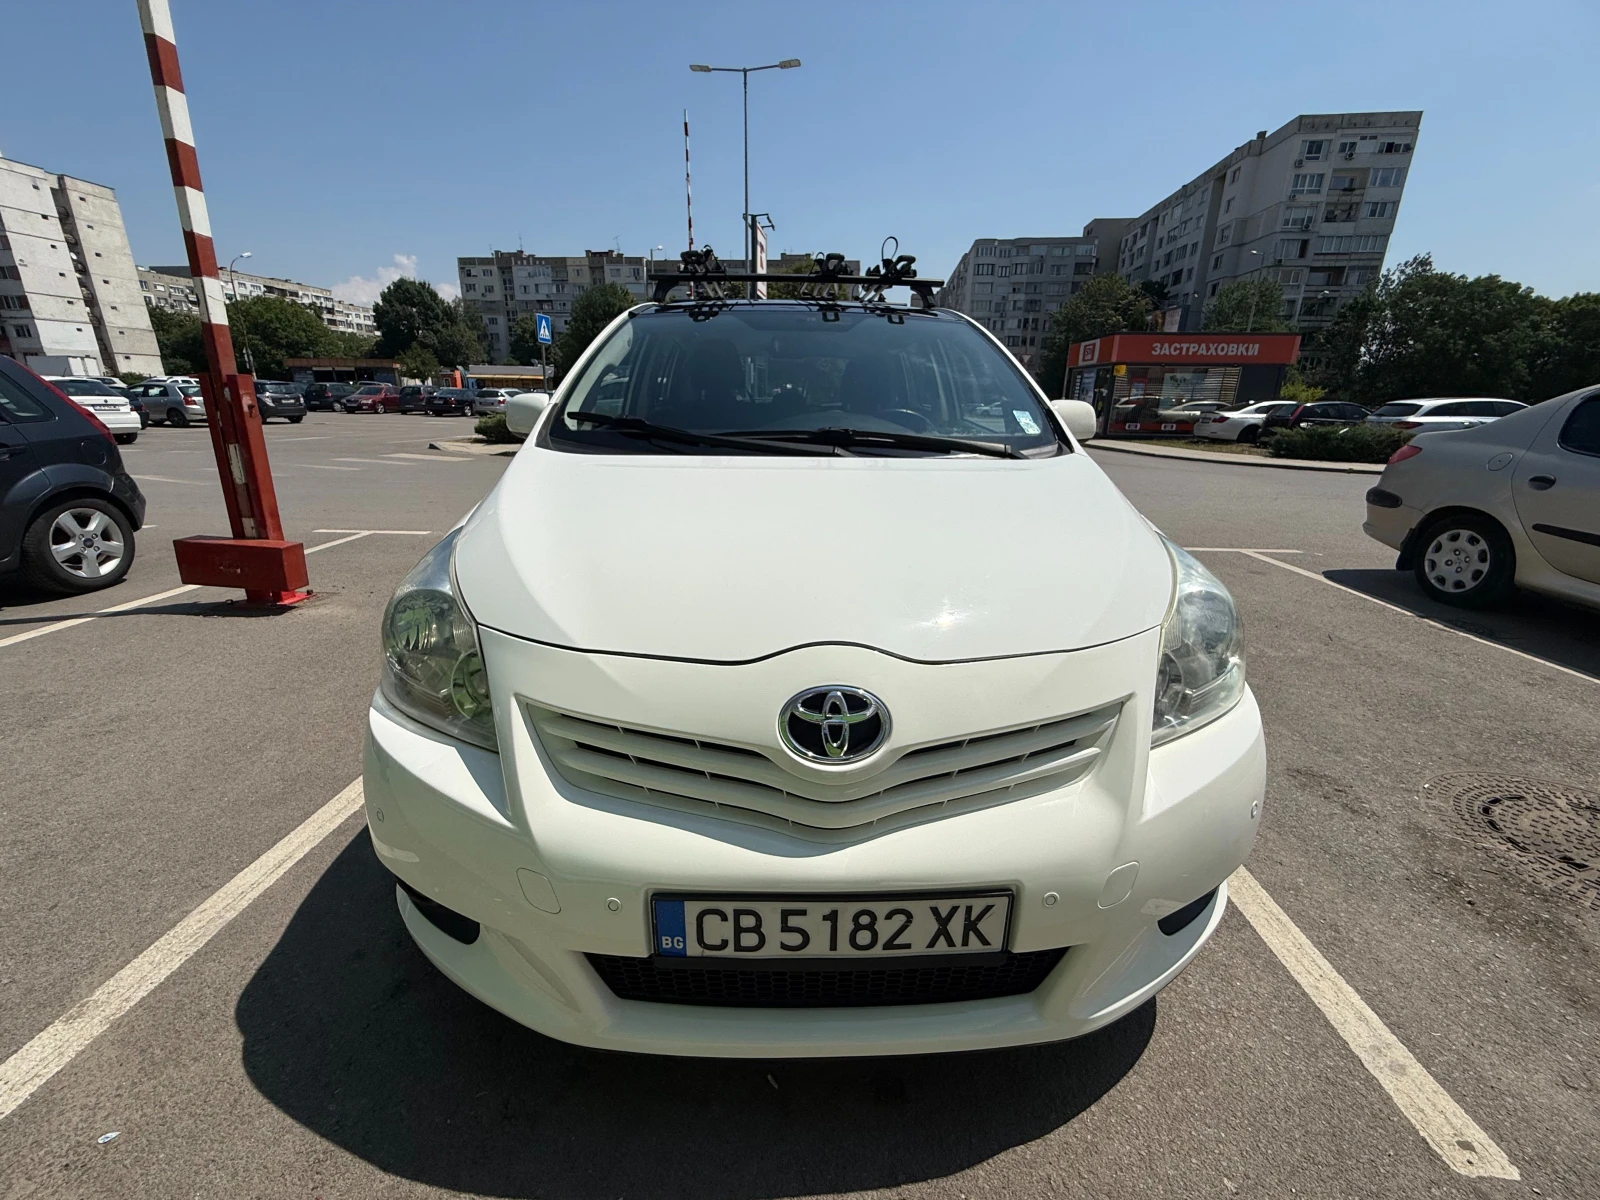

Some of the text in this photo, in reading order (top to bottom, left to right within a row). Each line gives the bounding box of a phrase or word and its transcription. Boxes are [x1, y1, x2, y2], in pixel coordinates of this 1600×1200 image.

[1151, 343, 1259, 355] ЗАСТРАХОВКИ
[695, 904, 996, 952] CB 5182 XK
[661, 936, 683, 949] BG
